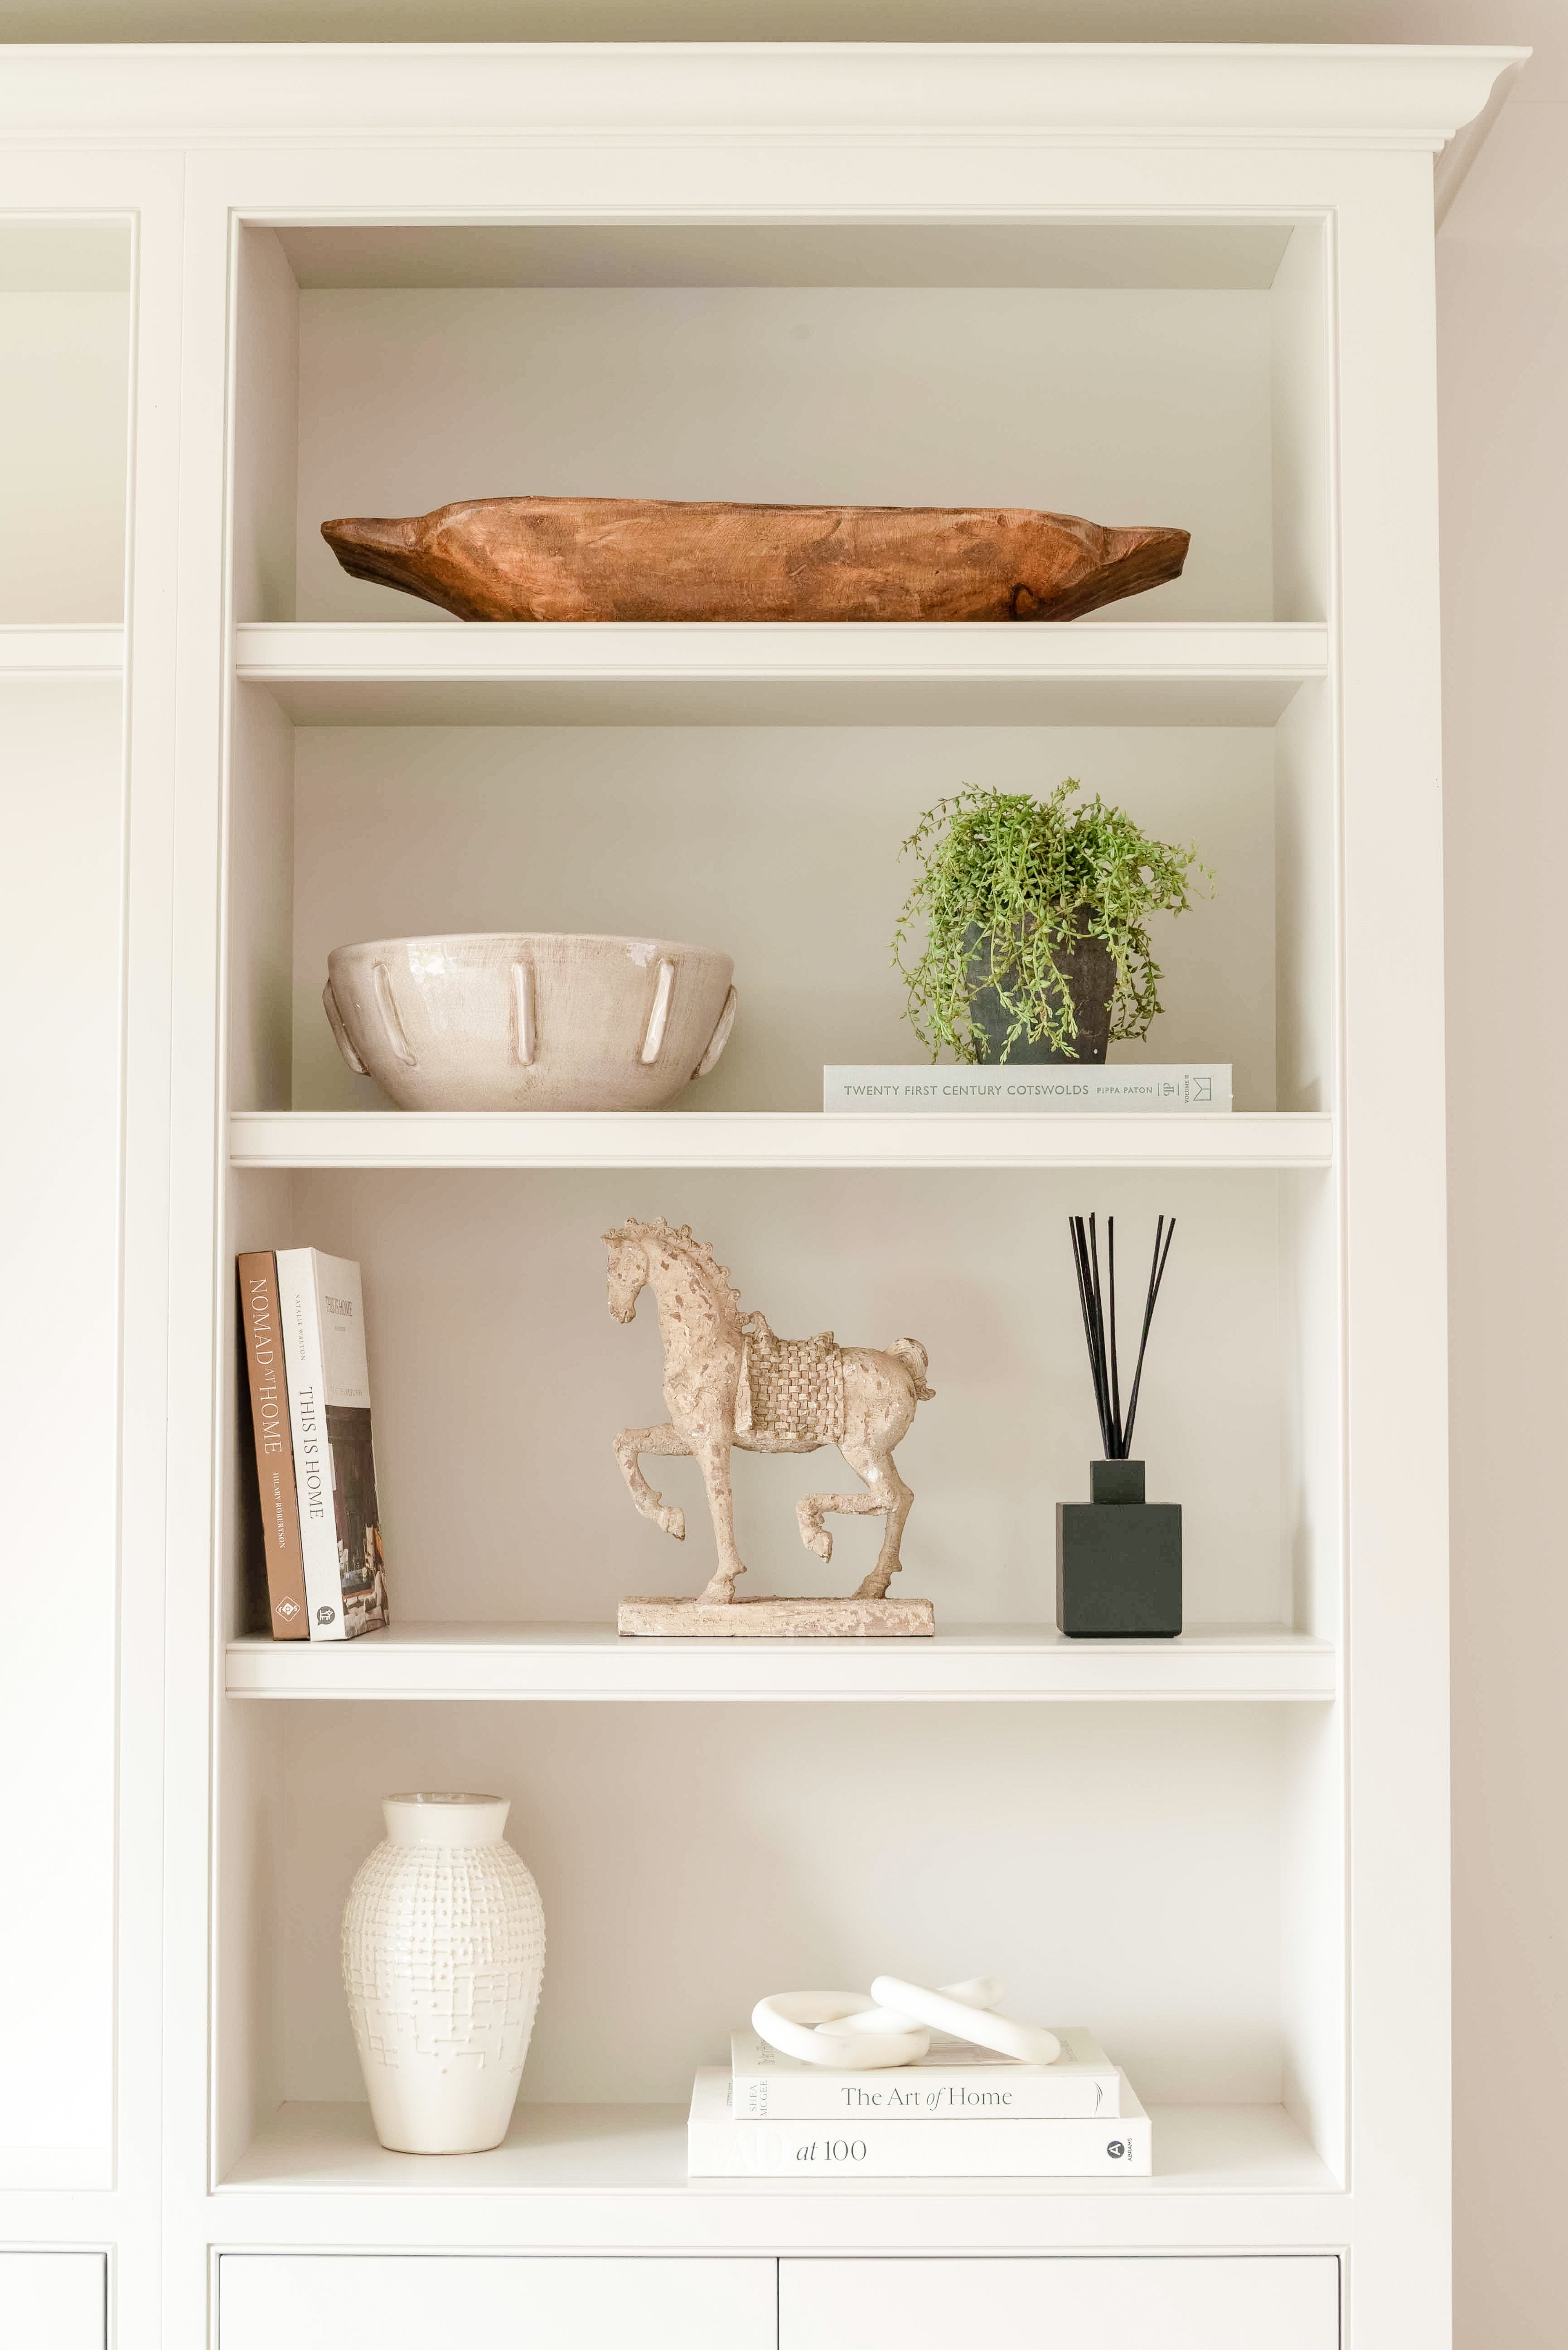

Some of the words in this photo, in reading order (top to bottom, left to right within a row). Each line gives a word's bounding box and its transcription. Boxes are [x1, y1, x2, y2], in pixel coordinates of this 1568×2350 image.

[844, 1086, 899, 1096] TWENTY
[905, 1086, 937, 1096] FIRST
[943, 1085, 1002, 1096] CENTURY
[1007, 1085, 1089, 1096] COTSWOLDS
[250, 1278, 274, 1364] NOMAD
[264, 1368, 276, 1382] AT
[259, 1385, 282, 1454] HOME
[299, 1386, 316, 1432] THIS
[303, 1438, 318, 1454] IS
[305, 1460, 324, 1519] HOME
[272, 1472, 280, 1500] HILARY
[276, 1502, 286, 1549] ROBERTSON
[749, 2084, 757, 2112] SHEA
[760, 2080, 768, 2117] MCGEE
[841, 2088, 882, 2106] The
[886, 2087, 920, 2106] Art
[926, 2087, 946, 2111] of
[948, 2087, 1012, 2105] Home
[796, 2141, 818, 2161] at
[824, 2140, 867, 2161] 100
